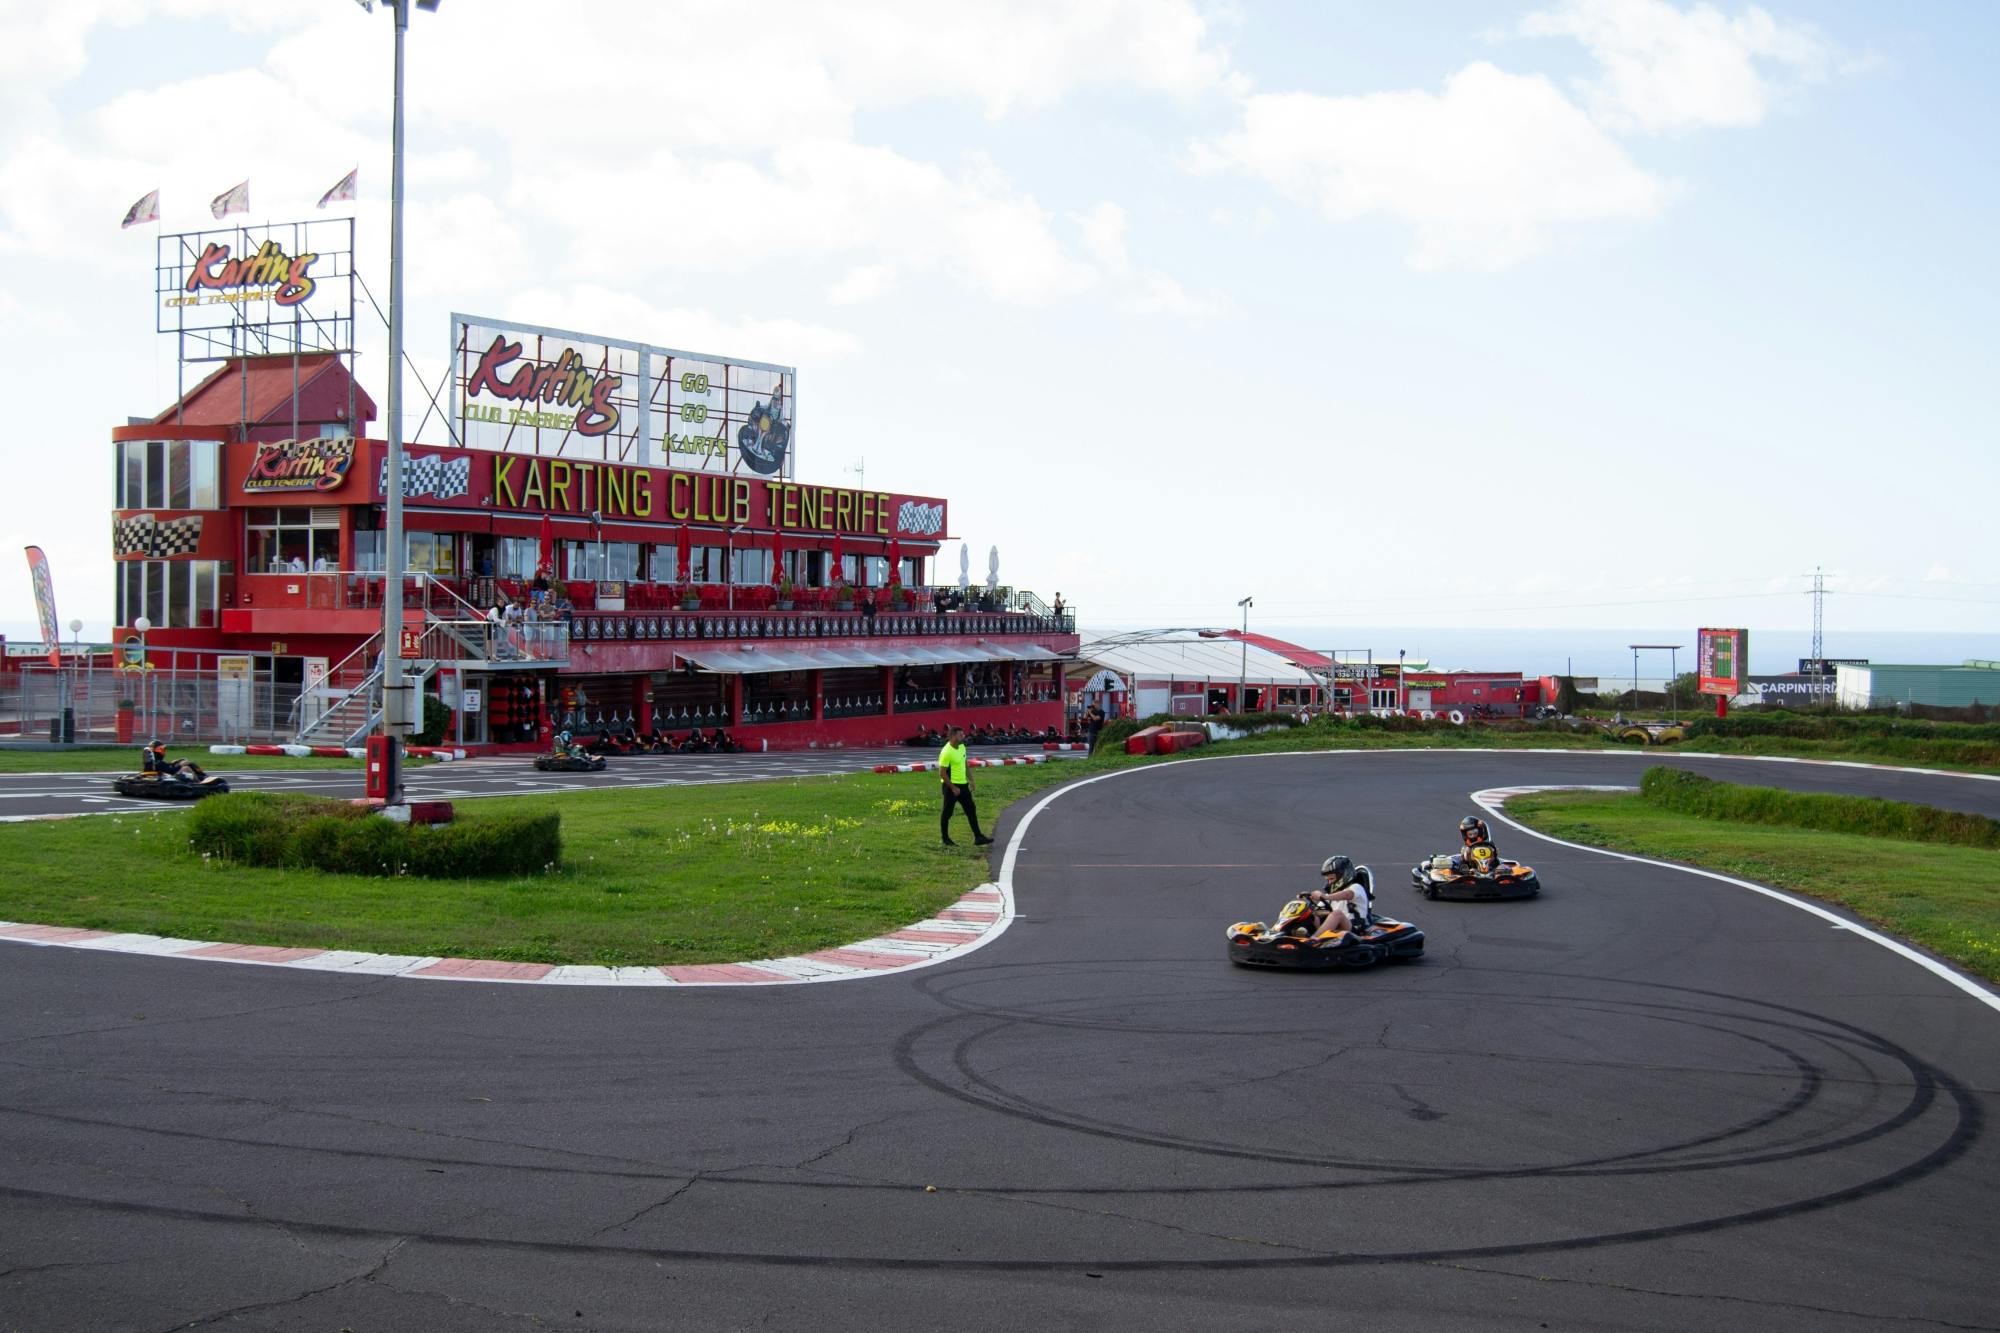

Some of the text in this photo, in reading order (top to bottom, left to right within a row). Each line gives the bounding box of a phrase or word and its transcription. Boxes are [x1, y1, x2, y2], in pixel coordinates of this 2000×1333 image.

[186, 240, 319, 306] Karting
[468, 335, 622, 437] Karting
[465, 404, 576, 431] CLUB TENERIFE
[680, 403, 708, 424] GO
[661, 432, 728, 458] KARTS
[252, 446, 345, 490] Karting
[495, 455, 890, 534] KARTING CLUB TENERIFE
[1480, 848, 1486, 856] 9
